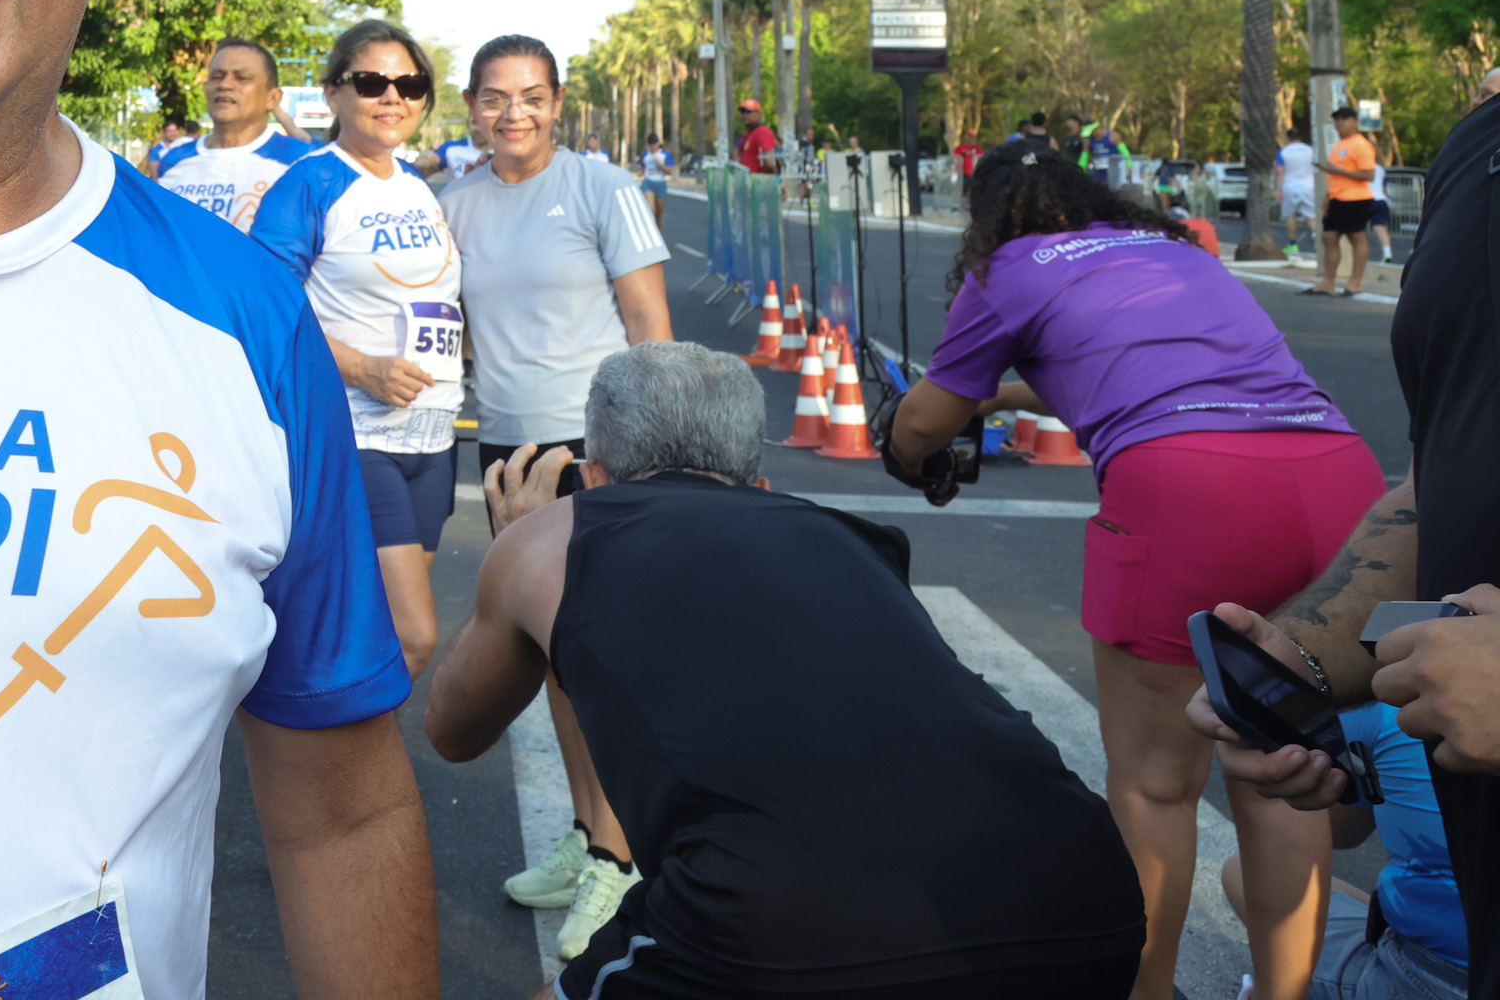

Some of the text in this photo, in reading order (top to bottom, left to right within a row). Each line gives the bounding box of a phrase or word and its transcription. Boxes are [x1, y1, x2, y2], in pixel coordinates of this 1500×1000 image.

[169, 183, 236, 197] ORRIDA
[371, 224, 442, 254] ALEPI
[414, 325, 461, 358] 5567
